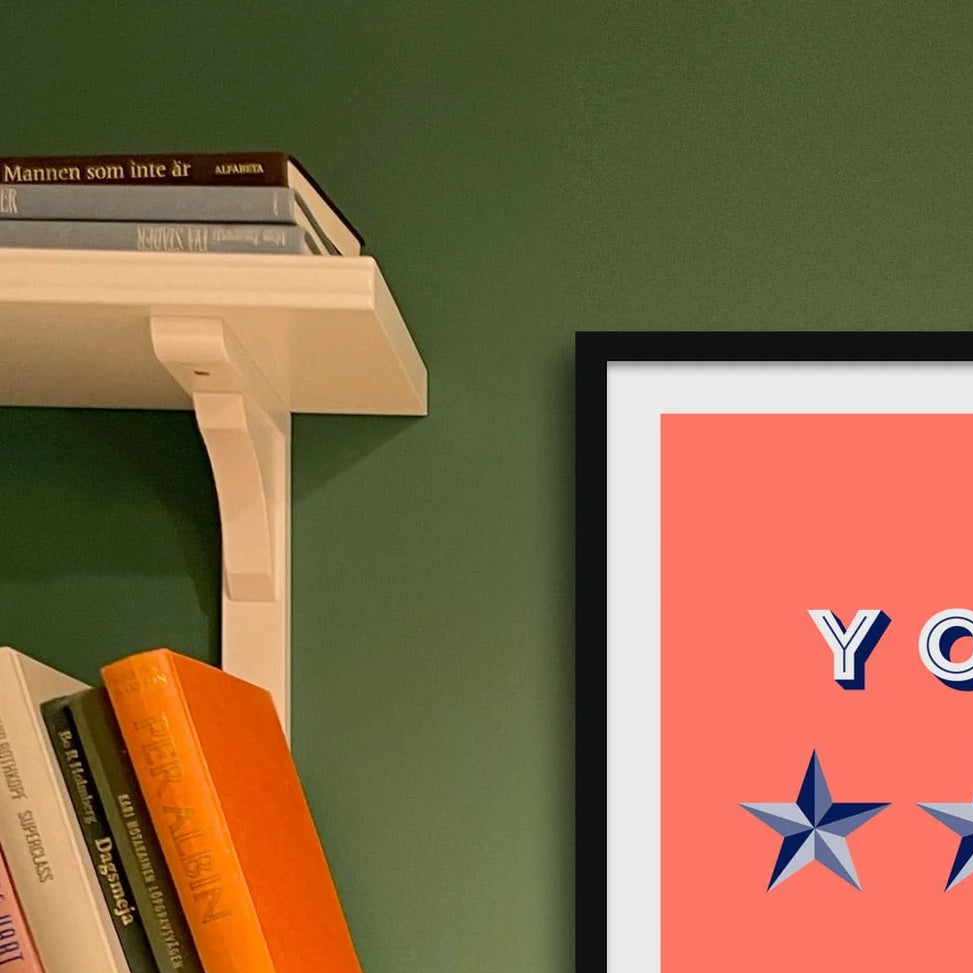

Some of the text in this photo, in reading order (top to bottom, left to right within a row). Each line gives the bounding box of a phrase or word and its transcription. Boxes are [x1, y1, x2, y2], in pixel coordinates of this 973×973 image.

[4, 159, 192, 182] Mannen som inte är
[214, 163, 265, 175] ALFABETA
[17, 809, 53, 884] SUPERCLASS
[58, 729, 74, 748] Bo
[69, 761, 98, 825] Holmberg
[95, 836, 136, 926] Dagsmeja
[133, 711, 184, 797] PER
[162, 805, 233, 925] ALBIN
